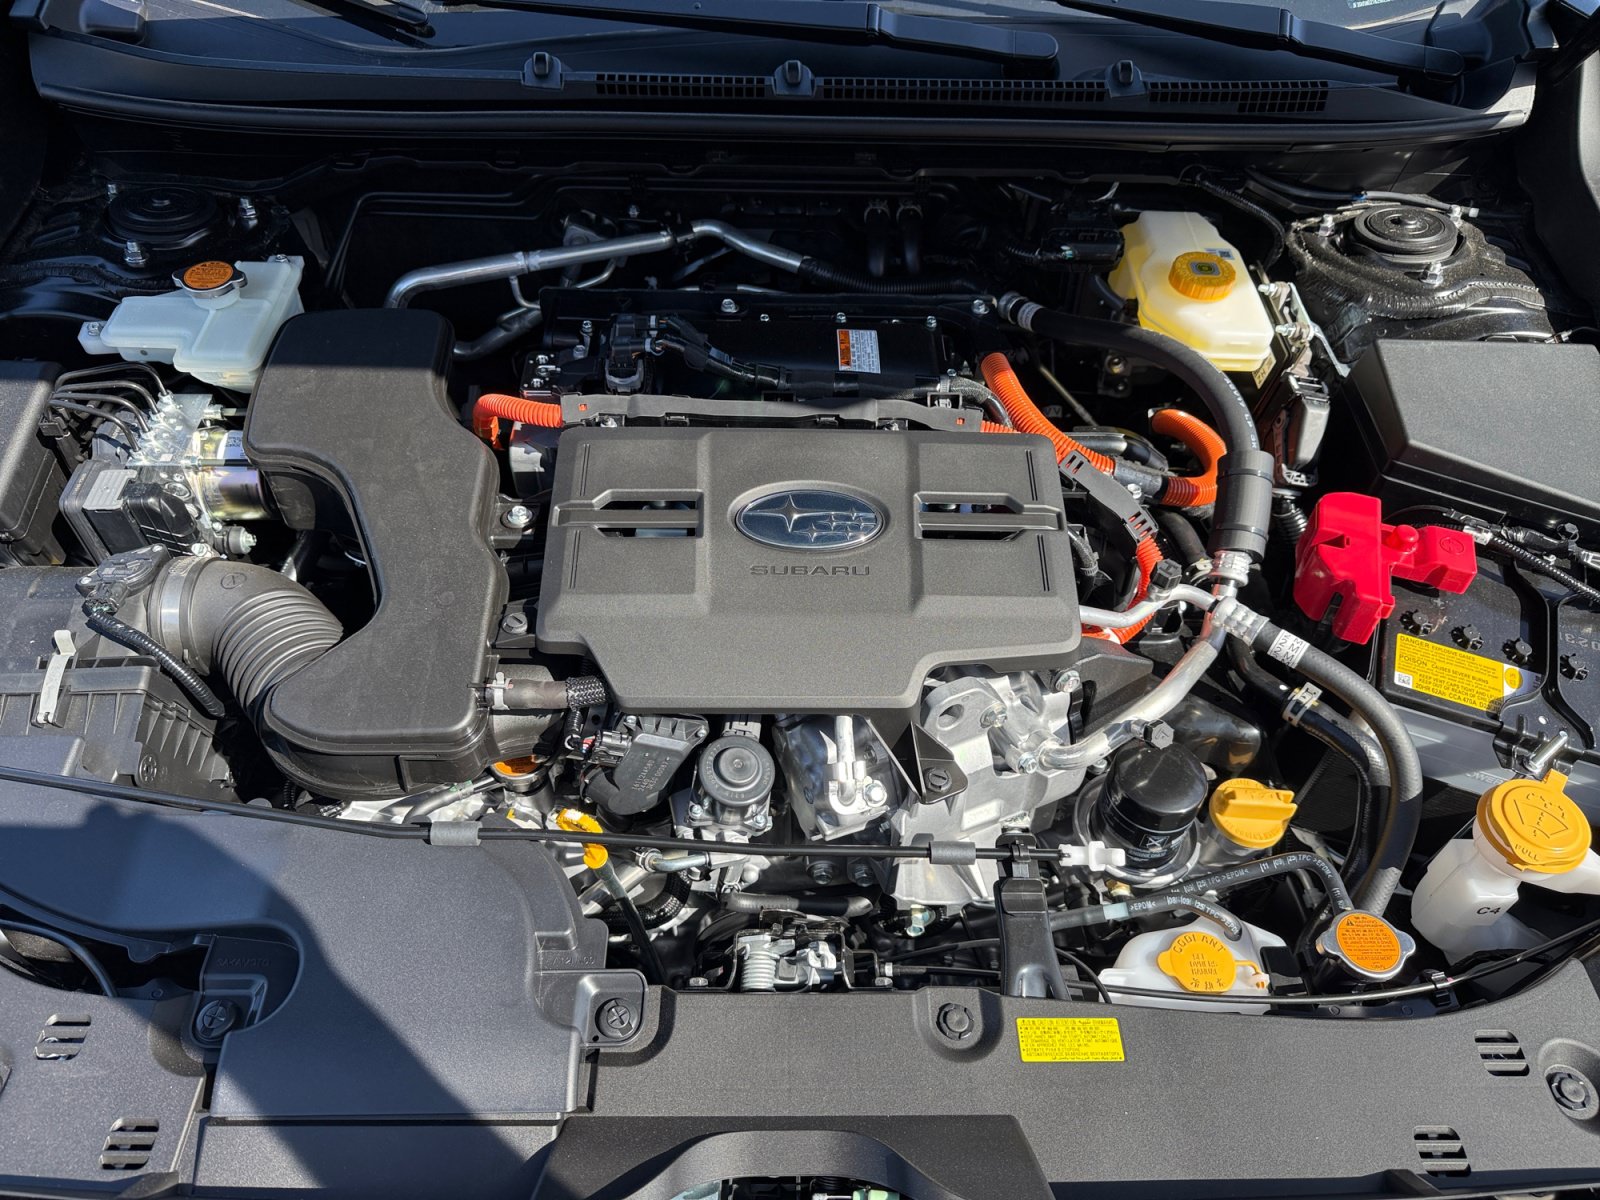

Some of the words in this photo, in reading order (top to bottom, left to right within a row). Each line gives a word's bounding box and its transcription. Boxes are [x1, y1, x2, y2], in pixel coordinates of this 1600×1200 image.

[750, 565, 870, 576] SUBARU
[1400, 635, 1430, 648] DANGER
[1400, 655, 1427, 667] POISON
[1431, 663, 1451, 674] CAUSES
[1452, 669, 1471, 679] SEVERE
[1472, 675, 1489, 684] BURNS
[1419, 673, 1432, 682] KEEP
[1415, 683, 1431, 693] 20HR
[1449, 693, 1462, 704] CCA
[1418, 678, 1431, 687] KEEP
[1432, 682, 1442, 690] OUT
[1450, 686, 1468, 697] REACH
[1515, 843, 1539, 861] PULL
[1477, 906, 1501, 915] C4
